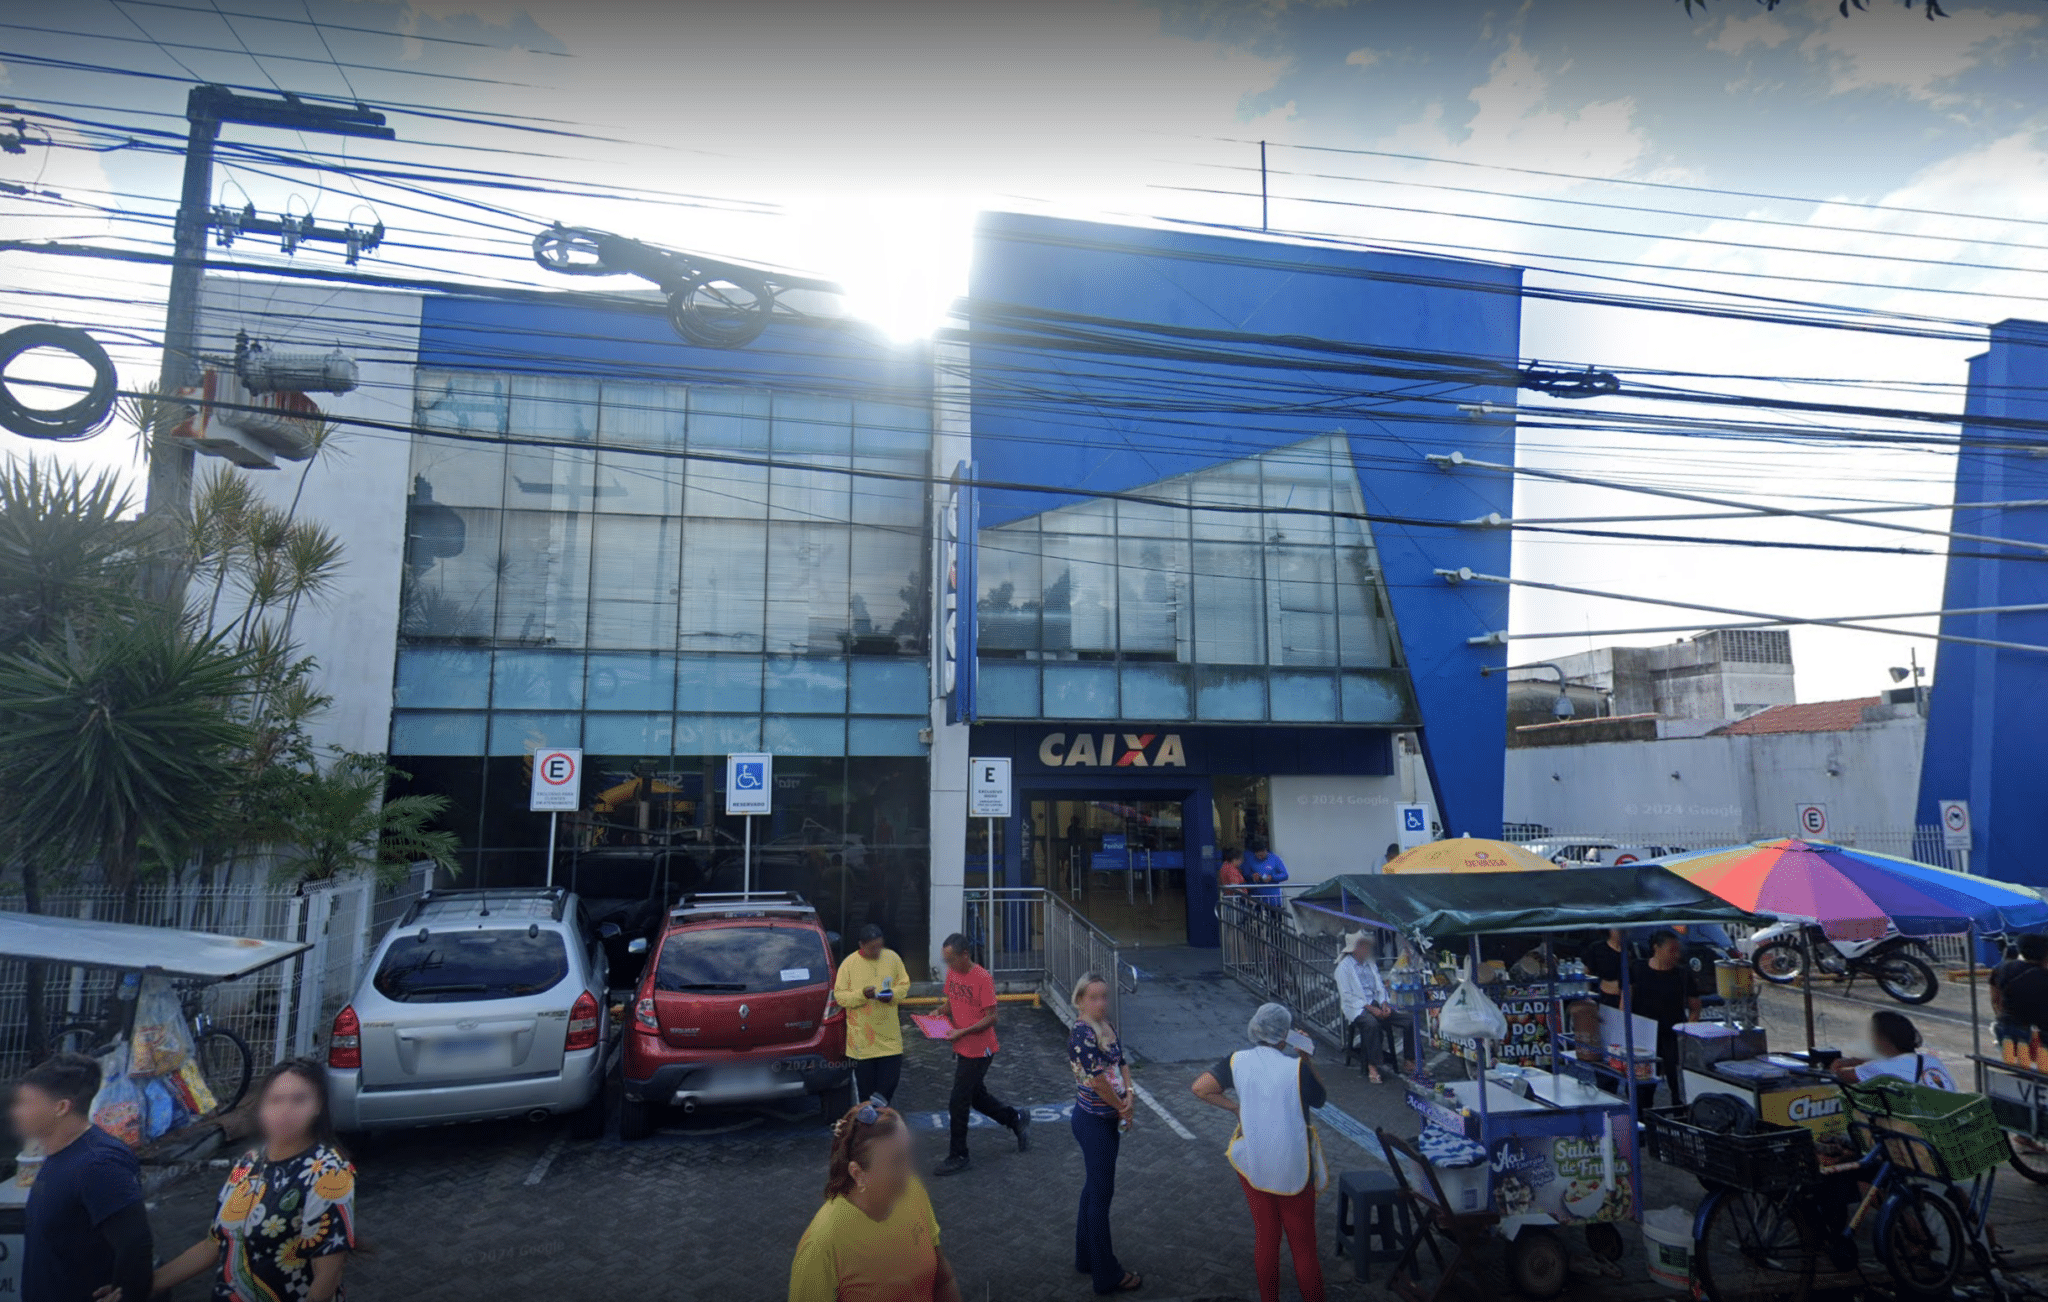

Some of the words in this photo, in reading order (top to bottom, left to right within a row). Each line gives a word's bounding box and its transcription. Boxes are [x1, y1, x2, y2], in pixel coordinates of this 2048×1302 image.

[1039, 732, 1187, 767] CAIXA
[550, 760, 564, 778] E
[985, 766, 996, 783] E
[1808, 812, 1819, 828] E
[1501, 1001, 1550, 1015] ALAD
[1512, 1023, 1537, 1036] DO
[1498, 1042, 1553, 1057] IRMÃO
[1577, 1159, 1628, 1176] Fruas
